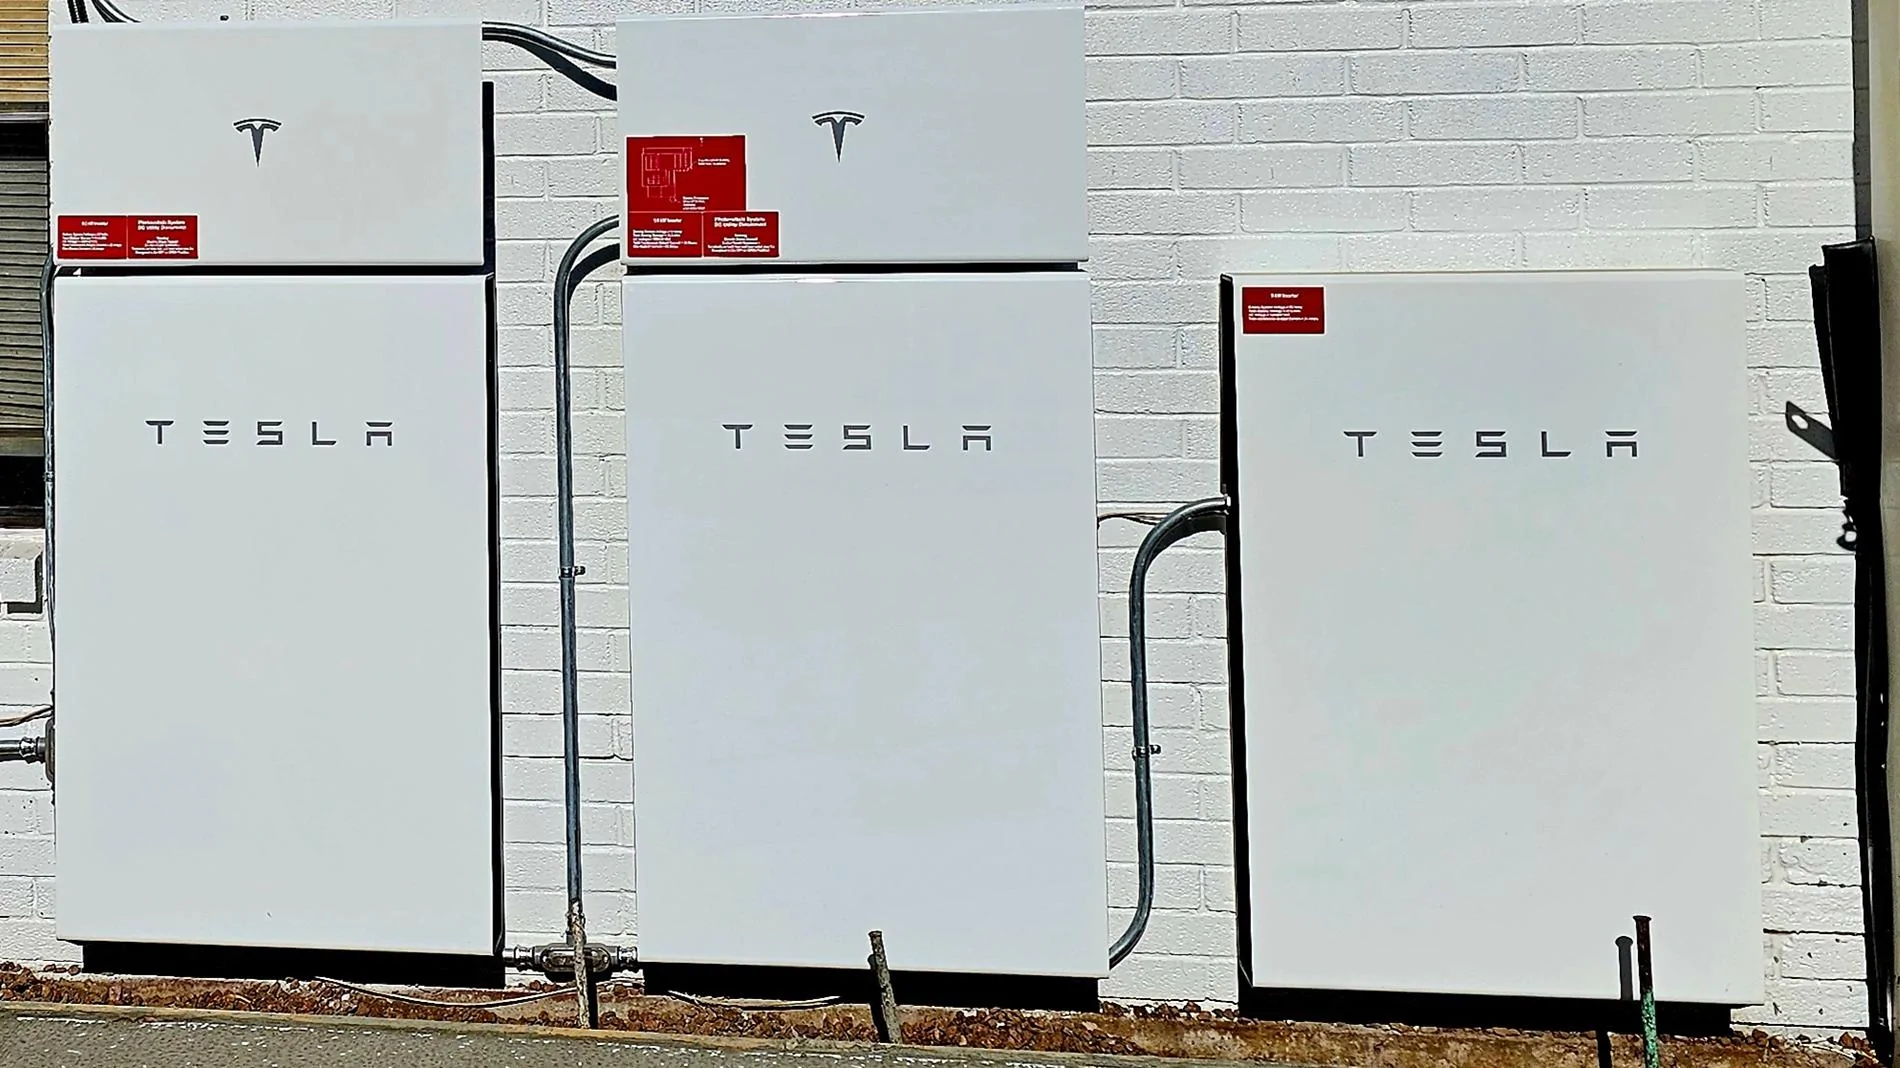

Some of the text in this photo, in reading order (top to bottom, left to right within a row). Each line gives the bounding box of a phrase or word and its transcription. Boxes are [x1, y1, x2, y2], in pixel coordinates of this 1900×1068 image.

[145, 420, 393, 447] TESLA
[721, 423, 992, 452] TESLA
[1343, 430, 1638, 458] TESLA
